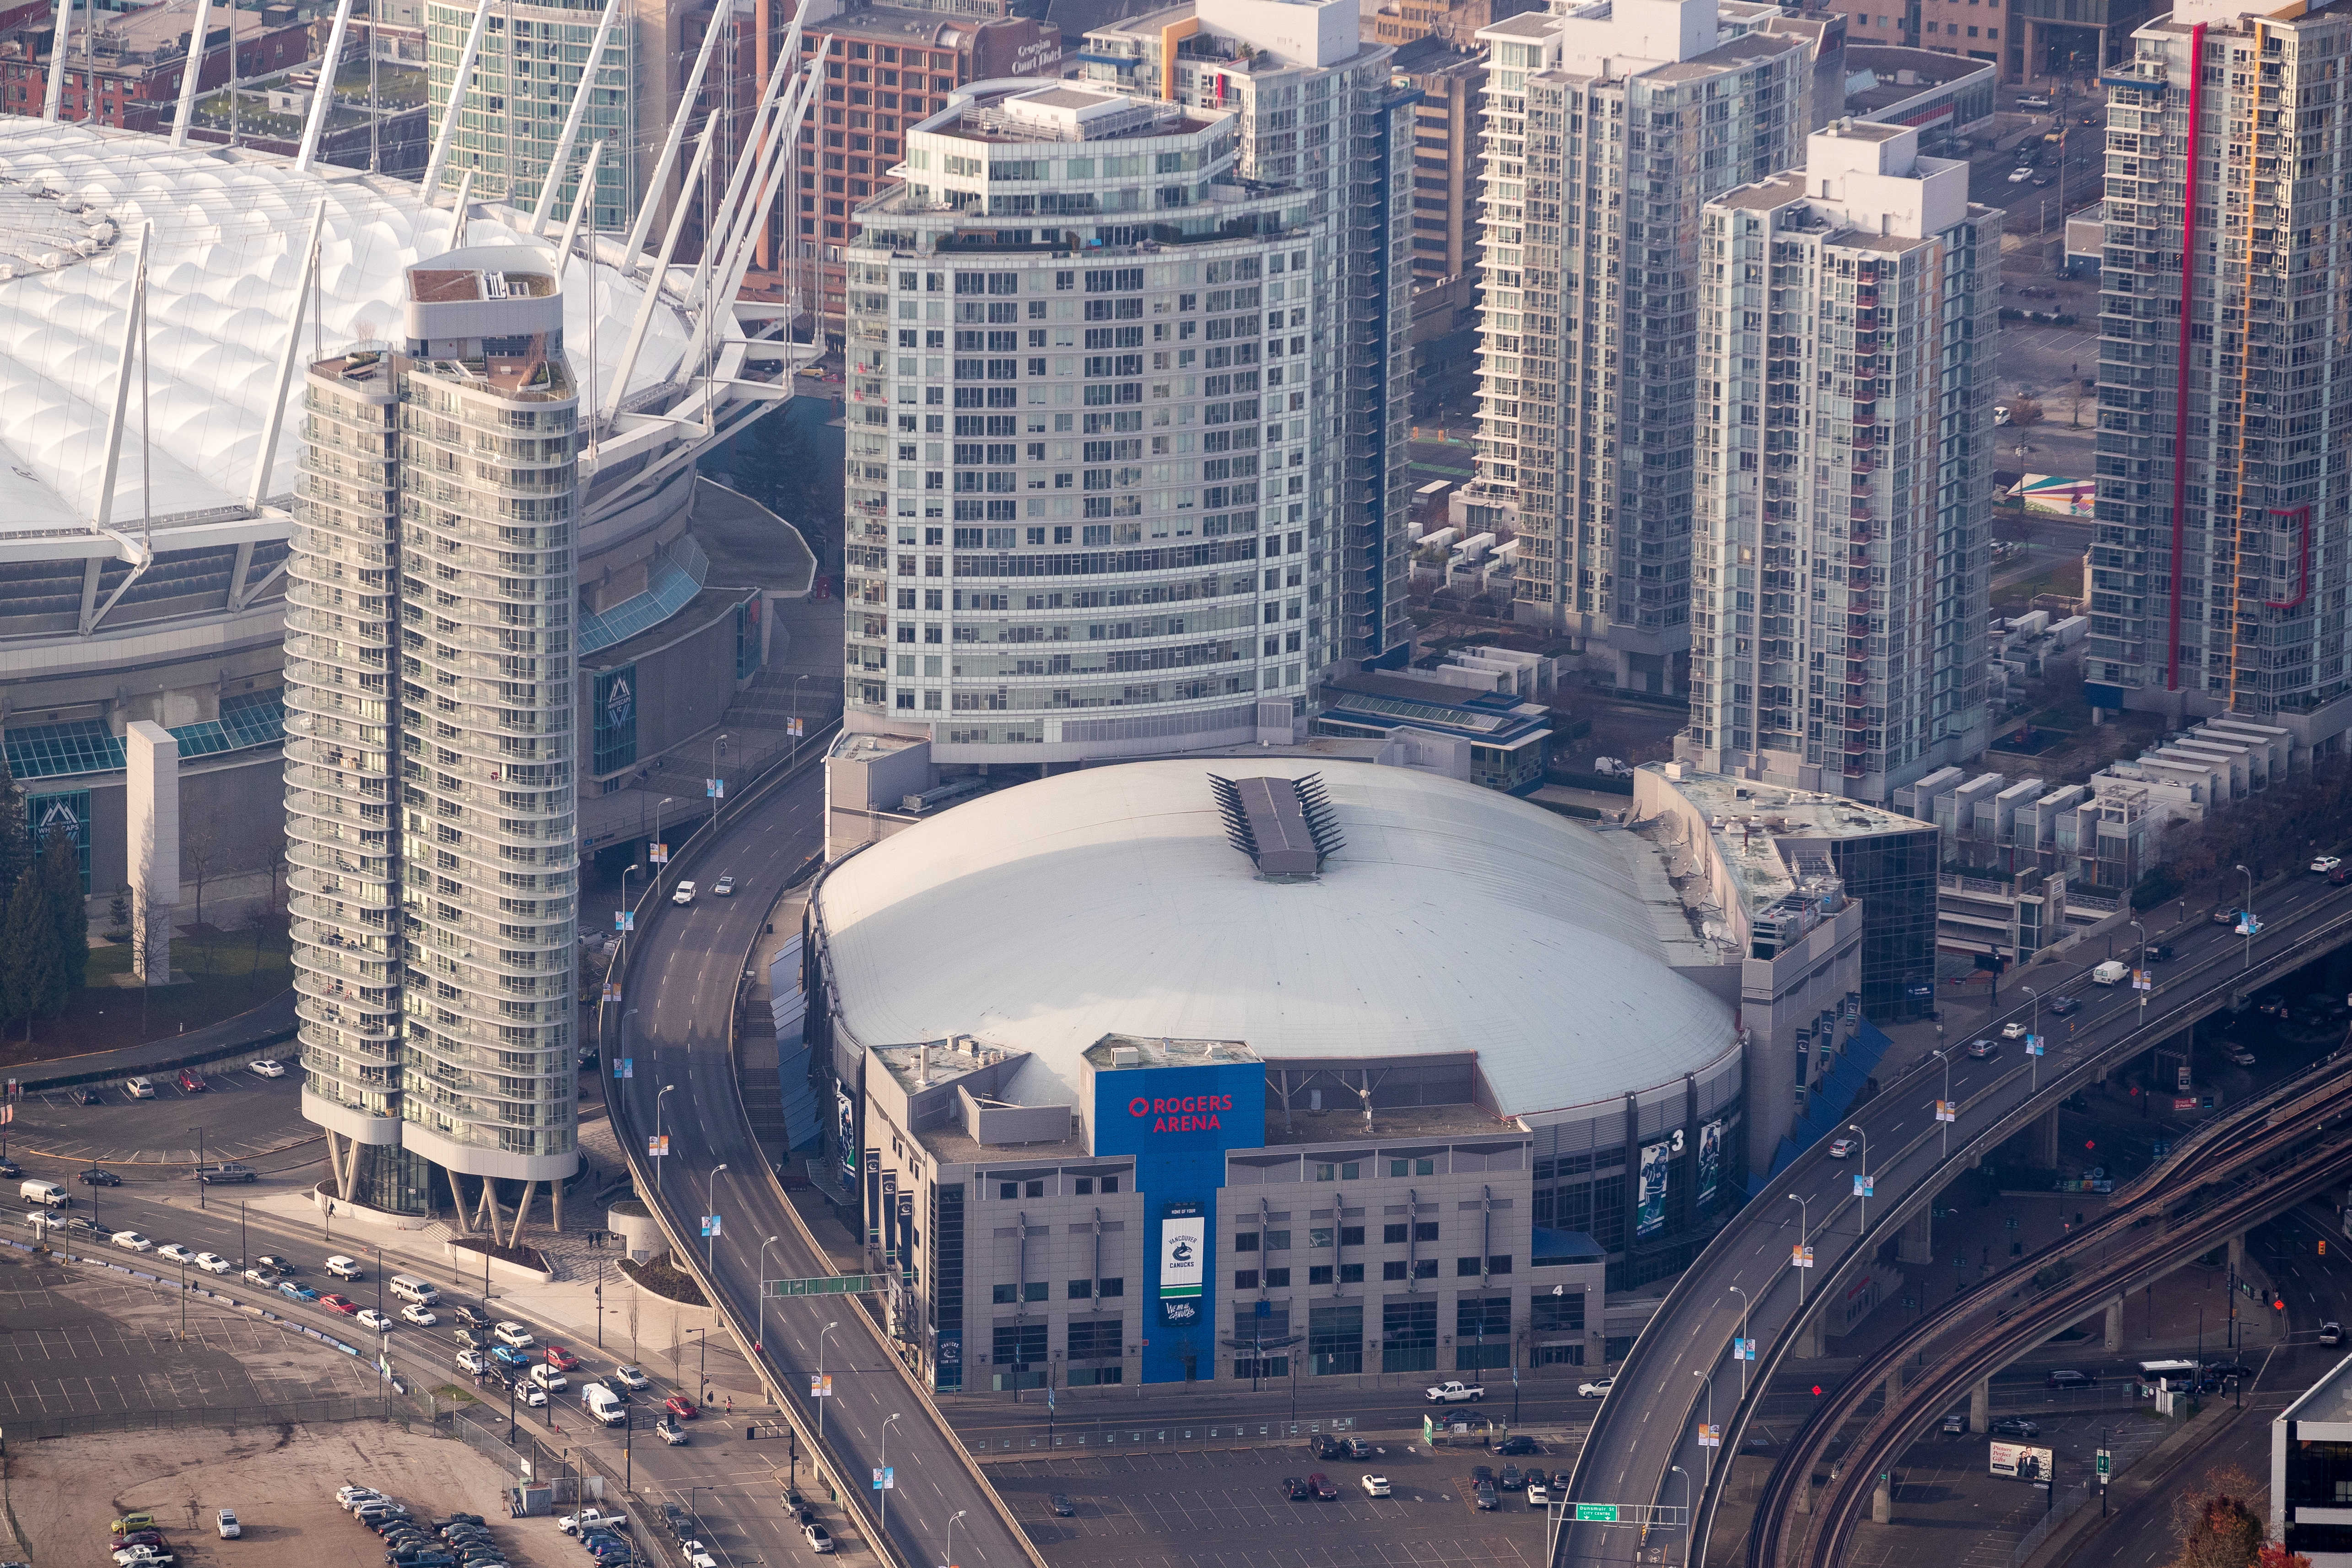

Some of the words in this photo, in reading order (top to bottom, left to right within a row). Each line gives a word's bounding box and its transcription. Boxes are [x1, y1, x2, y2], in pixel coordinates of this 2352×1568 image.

[1018, 39, 1051, 57] Georgian
[1012, 56, 1036, 74] Court
[1039, 45, 1061, 66] Hotel
[608, 696, 631, 709] WHITECAPS
[38, 824, 79, 834] WHCAPS
[1154, 1095, 1232, 1114] ROGERS
[1153, 1115, 1221, 1133] ARENA
[1672, 1129, 1684, 1151] 3
[1168, 1235, 1198, 1245] VANCOUVER
[1552, 1285, 1563, 1296] 4
[1166, 1303, 1176, 1314] WE
[1169, 1307, 1195, 1320] CANUCKS
